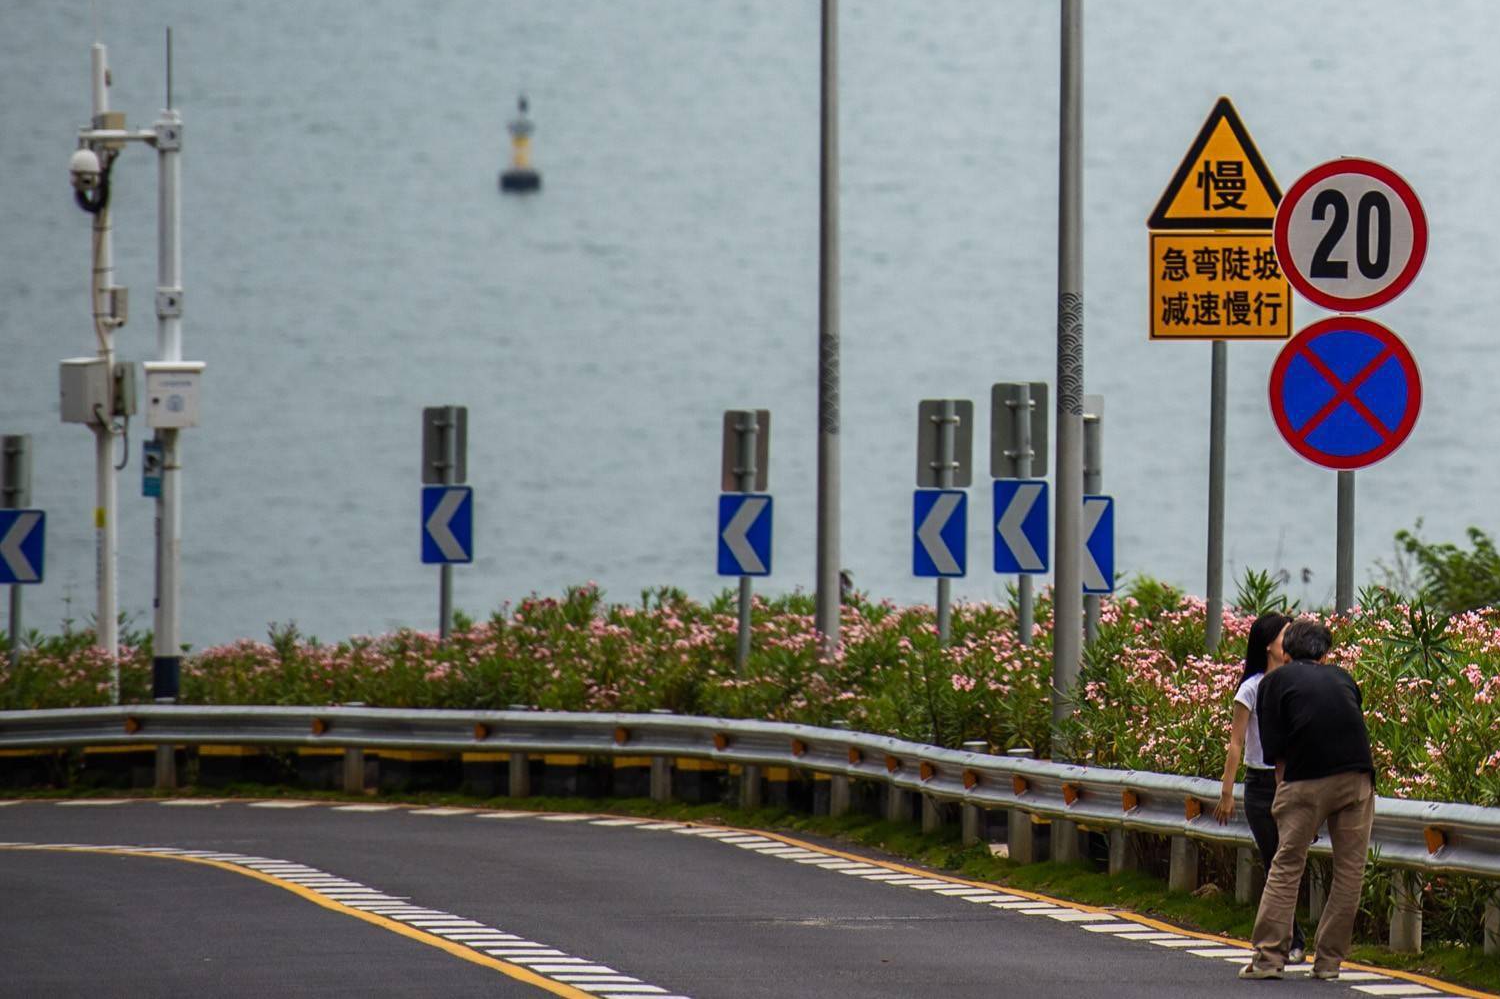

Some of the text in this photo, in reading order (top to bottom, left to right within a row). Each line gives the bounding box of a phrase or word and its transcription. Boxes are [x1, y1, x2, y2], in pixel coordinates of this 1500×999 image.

[1197, 160, 1248, 211] 慢
[1310, 189, 1391, 279] 20
[1161, 246, 1282, 282] 急弯陡坡
[1161, 292, 1282, 327] 减速慢行
